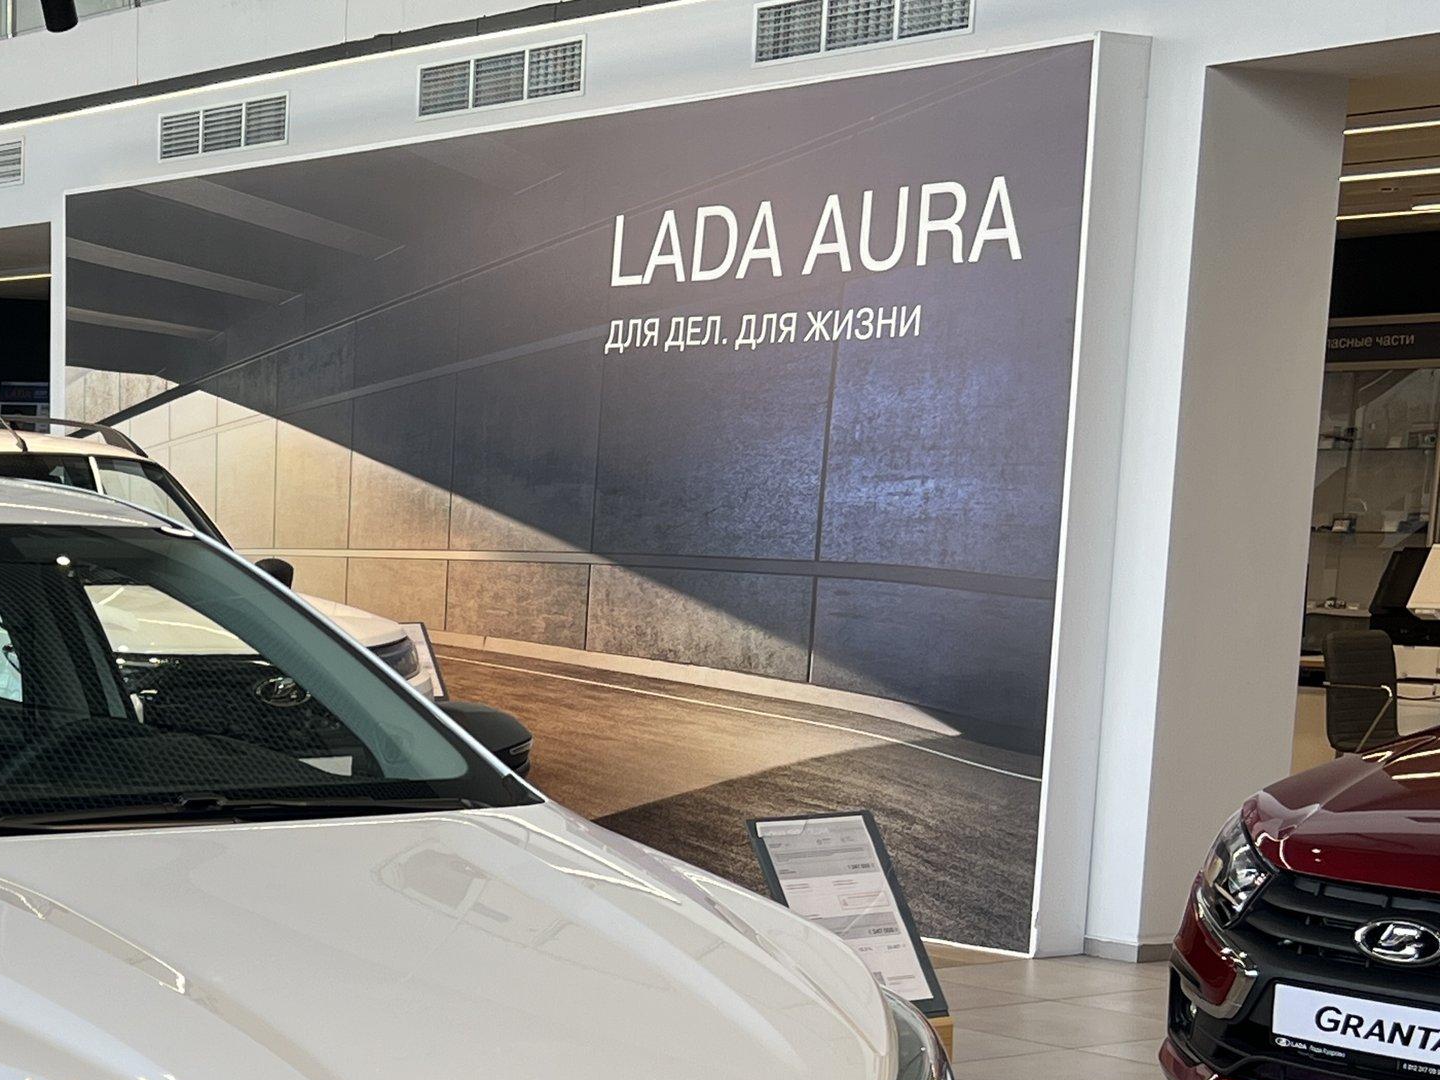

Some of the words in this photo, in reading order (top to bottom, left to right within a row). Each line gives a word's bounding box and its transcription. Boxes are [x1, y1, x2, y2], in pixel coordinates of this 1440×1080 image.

[611, 200, 783, 287] LADA
[801, 175, 1023, 276] AURA
[604, 317, 659, 354] ДЛЯ
[664, 315, 727, 352] ДЕЛ.
[735, 312, 798, 350] ДЛЯ
[803, 304, 922, 342] ЖИЗНИ
[1376, 335, 1415, 347] части
